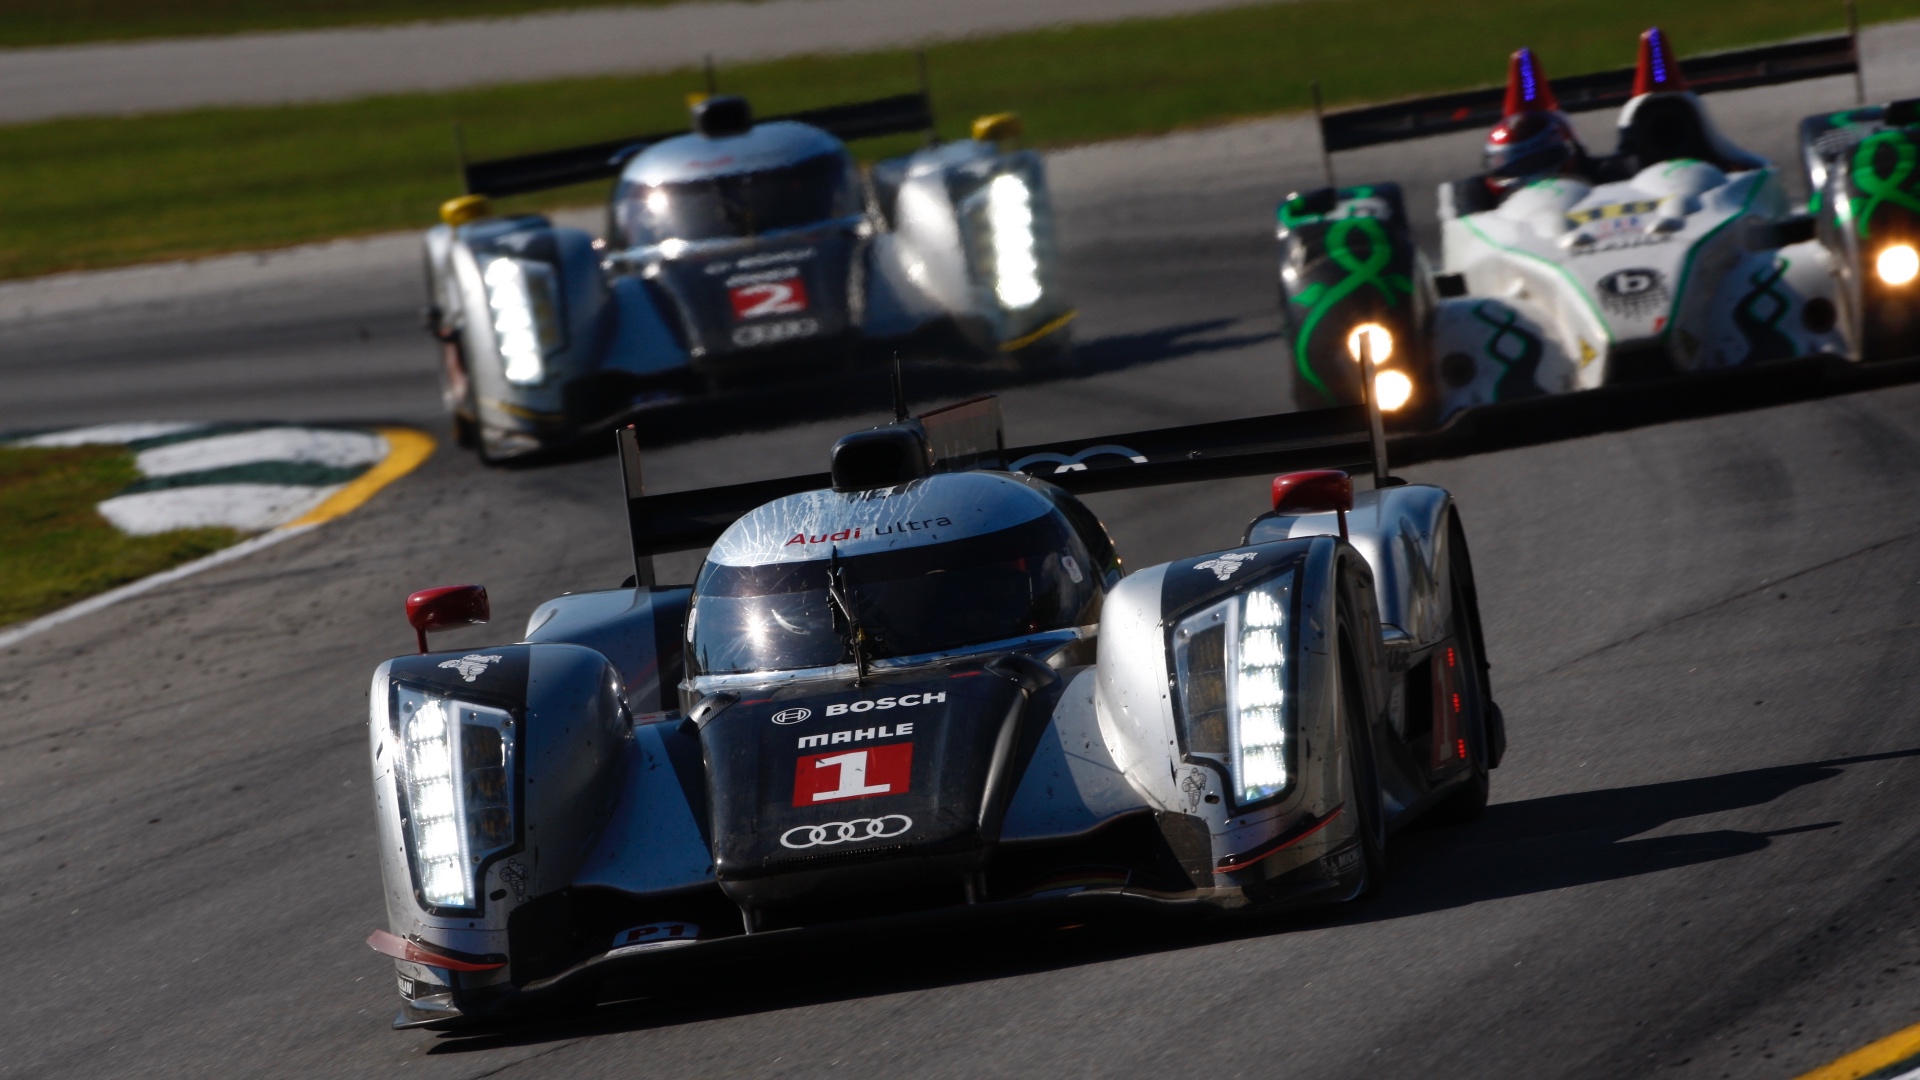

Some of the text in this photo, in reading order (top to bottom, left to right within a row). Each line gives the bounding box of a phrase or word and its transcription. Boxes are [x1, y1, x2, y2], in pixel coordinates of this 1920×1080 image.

[736, 284, 806, 318] 2
[784, 516, 952, 546] Audi ultra
[825, 691, 947, 717] BOSCH
[797, 722, 914, 750] MAHLE
[812, 750, 891, 802] 1
[626, 925, 684, 942] P1
